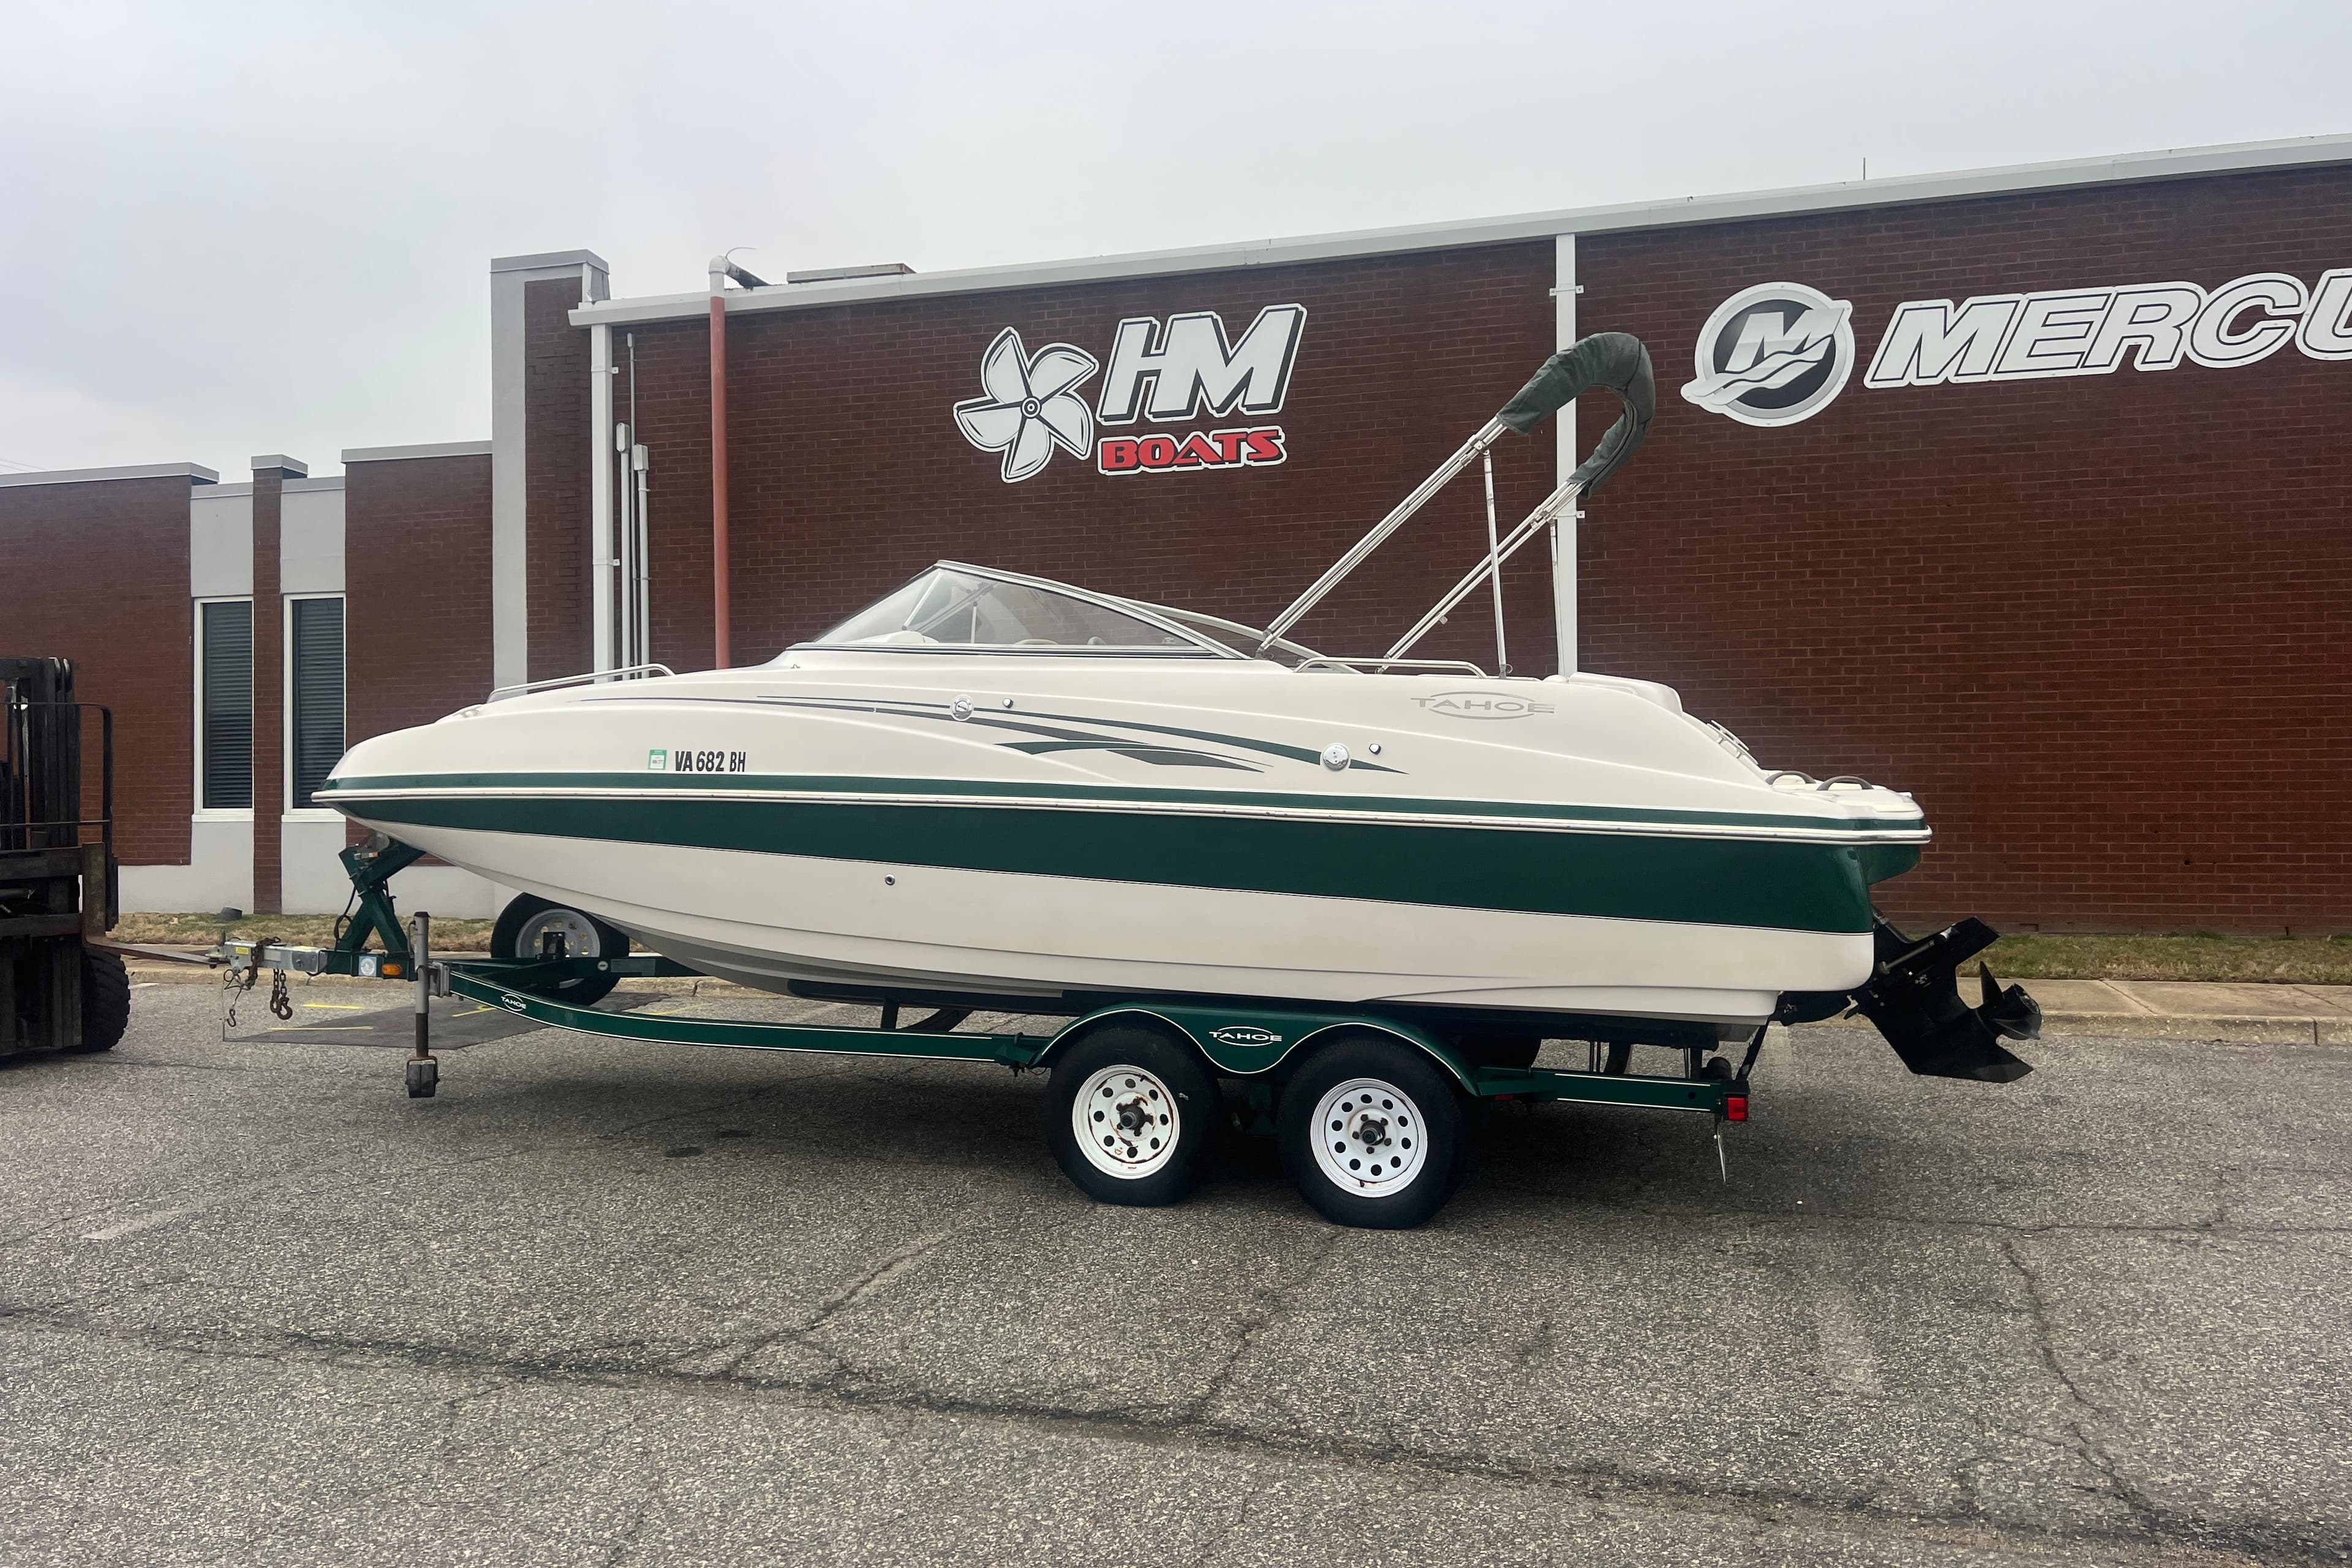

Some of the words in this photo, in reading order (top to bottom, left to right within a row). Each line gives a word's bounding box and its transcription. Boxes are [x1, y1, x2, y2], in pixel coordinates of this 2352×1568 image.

[1098, 304, 1305, 424] HM
[1101, 429, 1284, 472] BOATS
[1410, 696, 1556, 714] TAHOE
[675, 750, 693, 772] VA
[696, 750, 725, 772] 682
[729, 751, 747, 772] BH
[500, 995, 526, 1009] TAHOE
[1208, 1031, 1283, 1042] TAHOE
